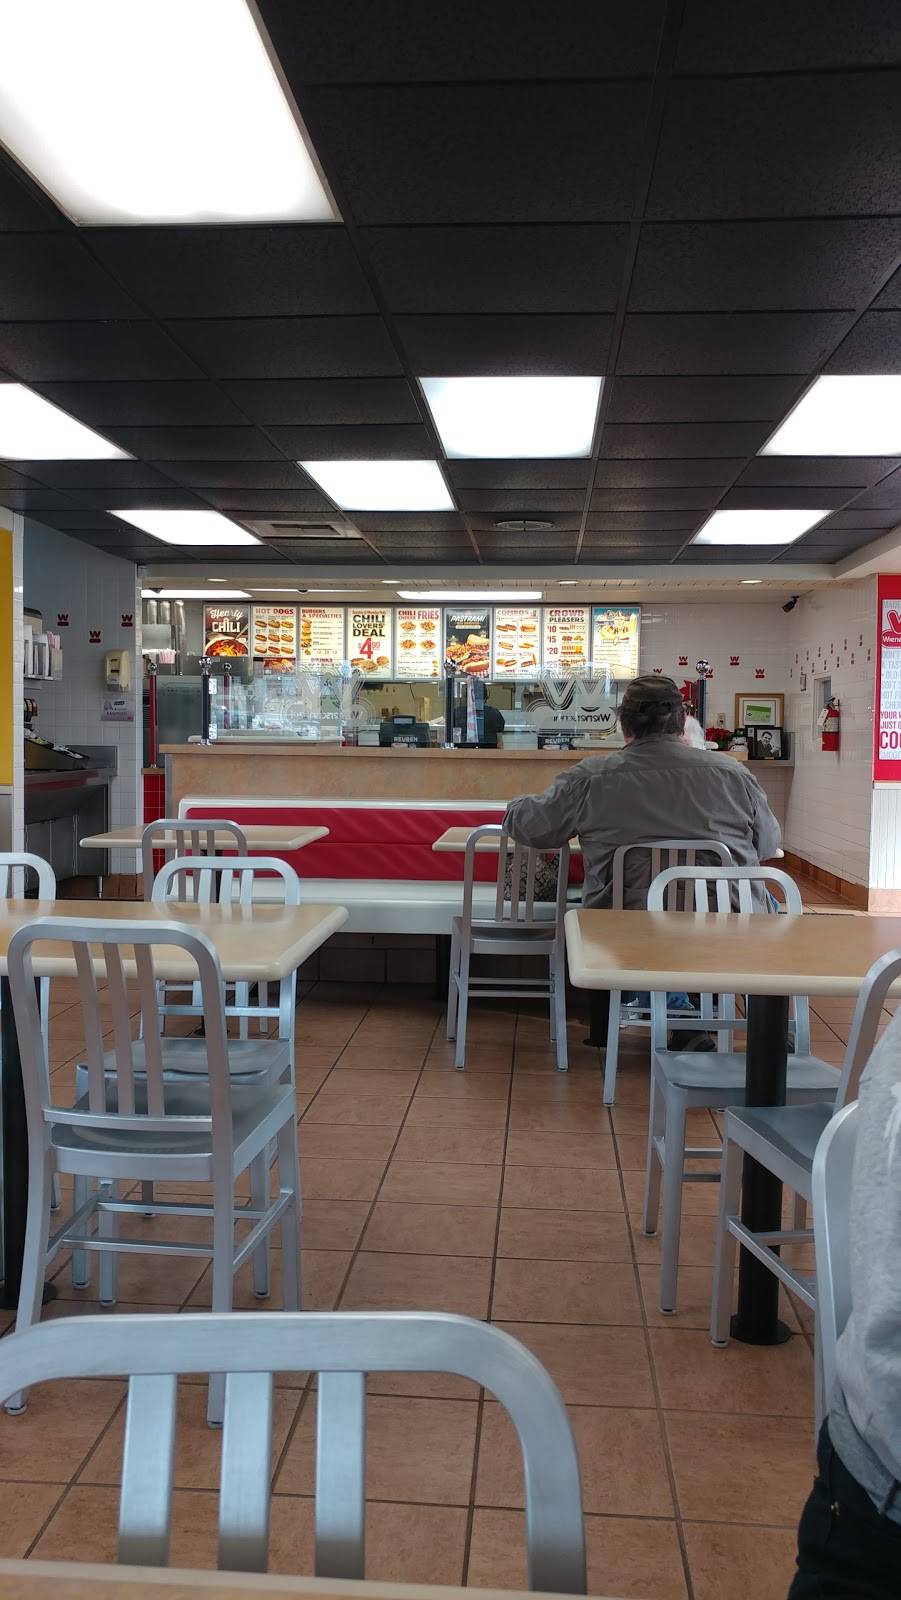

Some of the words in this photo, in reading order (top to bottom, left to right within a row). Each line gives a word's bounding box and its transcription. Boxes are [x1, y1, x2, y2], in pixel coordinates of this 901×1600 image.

[417, 610, 440, 620] FRIES
[549, 609, 585, 617] CROWD
[353, 614, 385, 623] CHILI
[212, 620, 241, 633] CHILI
[547, 625, 557, 633] $10
[353, 629, 385, 637] DEAL
[547, 647, 559, 655] $20
[880, 711, 898, 720] YOUR
[880, 721, 897, 730] JUST
